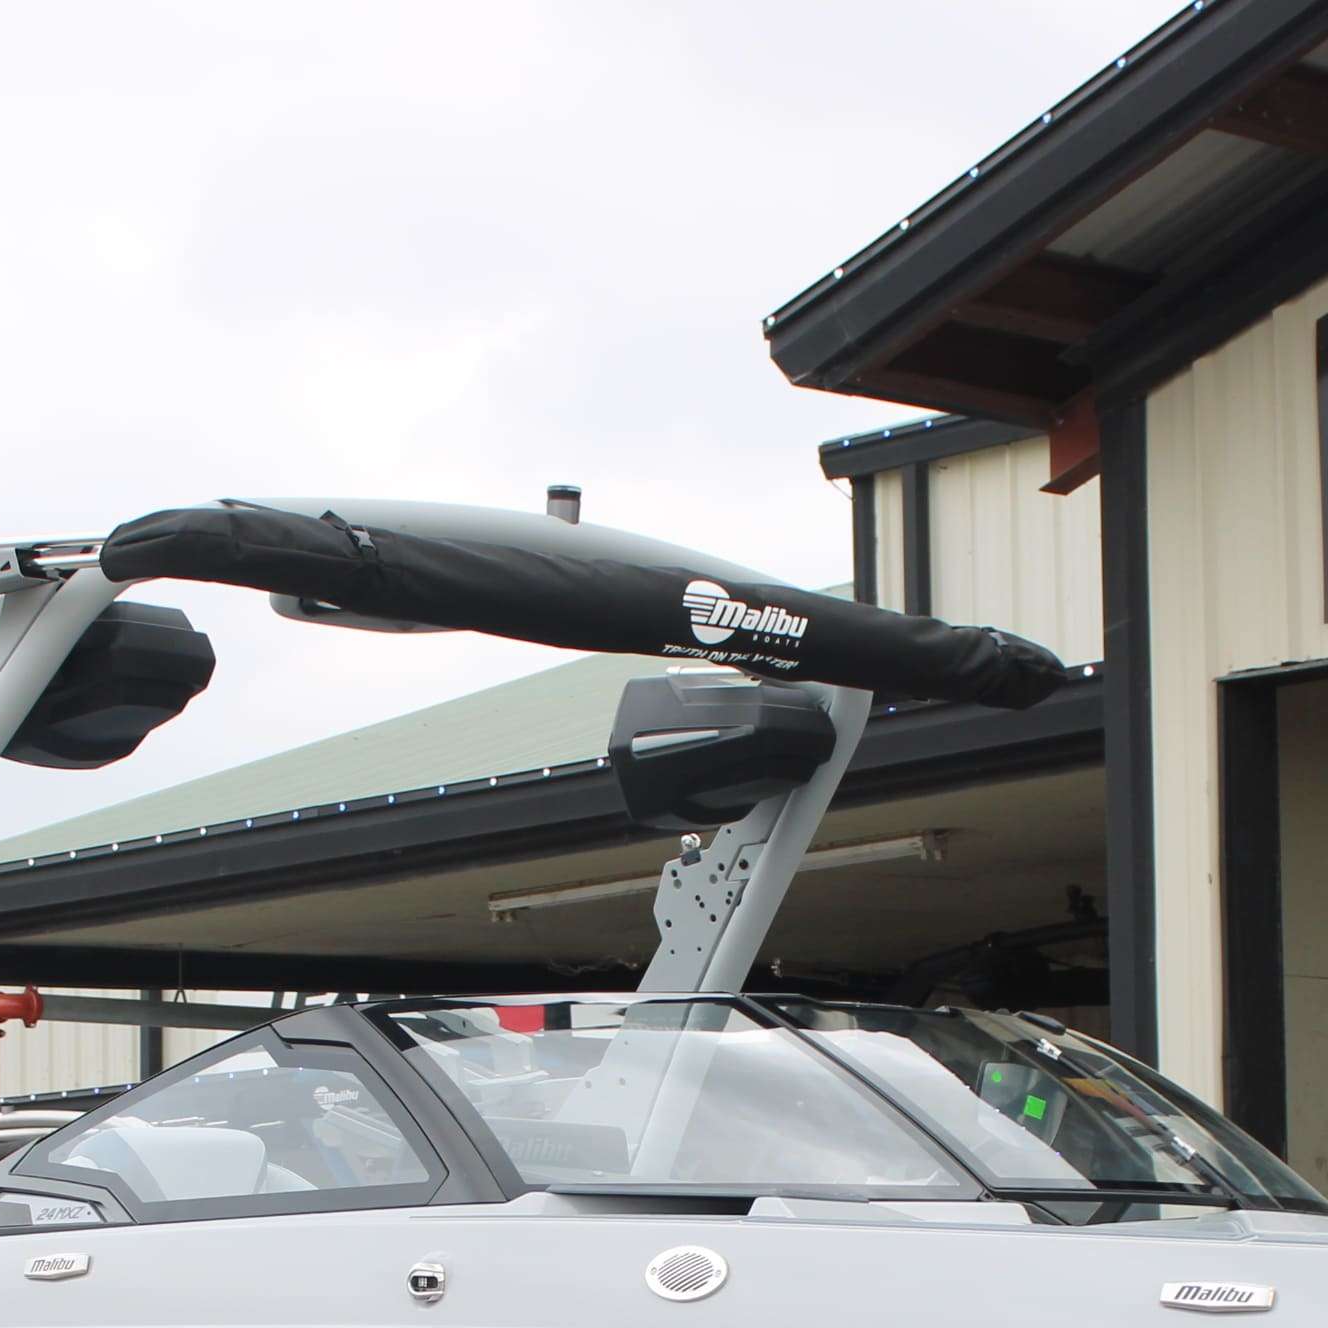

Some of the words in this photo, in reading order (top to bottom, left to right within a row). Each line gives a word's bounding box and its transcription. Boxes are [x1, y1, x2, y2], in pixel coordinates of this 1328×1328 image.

[708, 599, 809, 638] Malibu
[752, 633, 801, 648] BOATS
[30, 1257, 76, 1273] Malibu
[1174, 1284, 1255, 1303] Malibu
